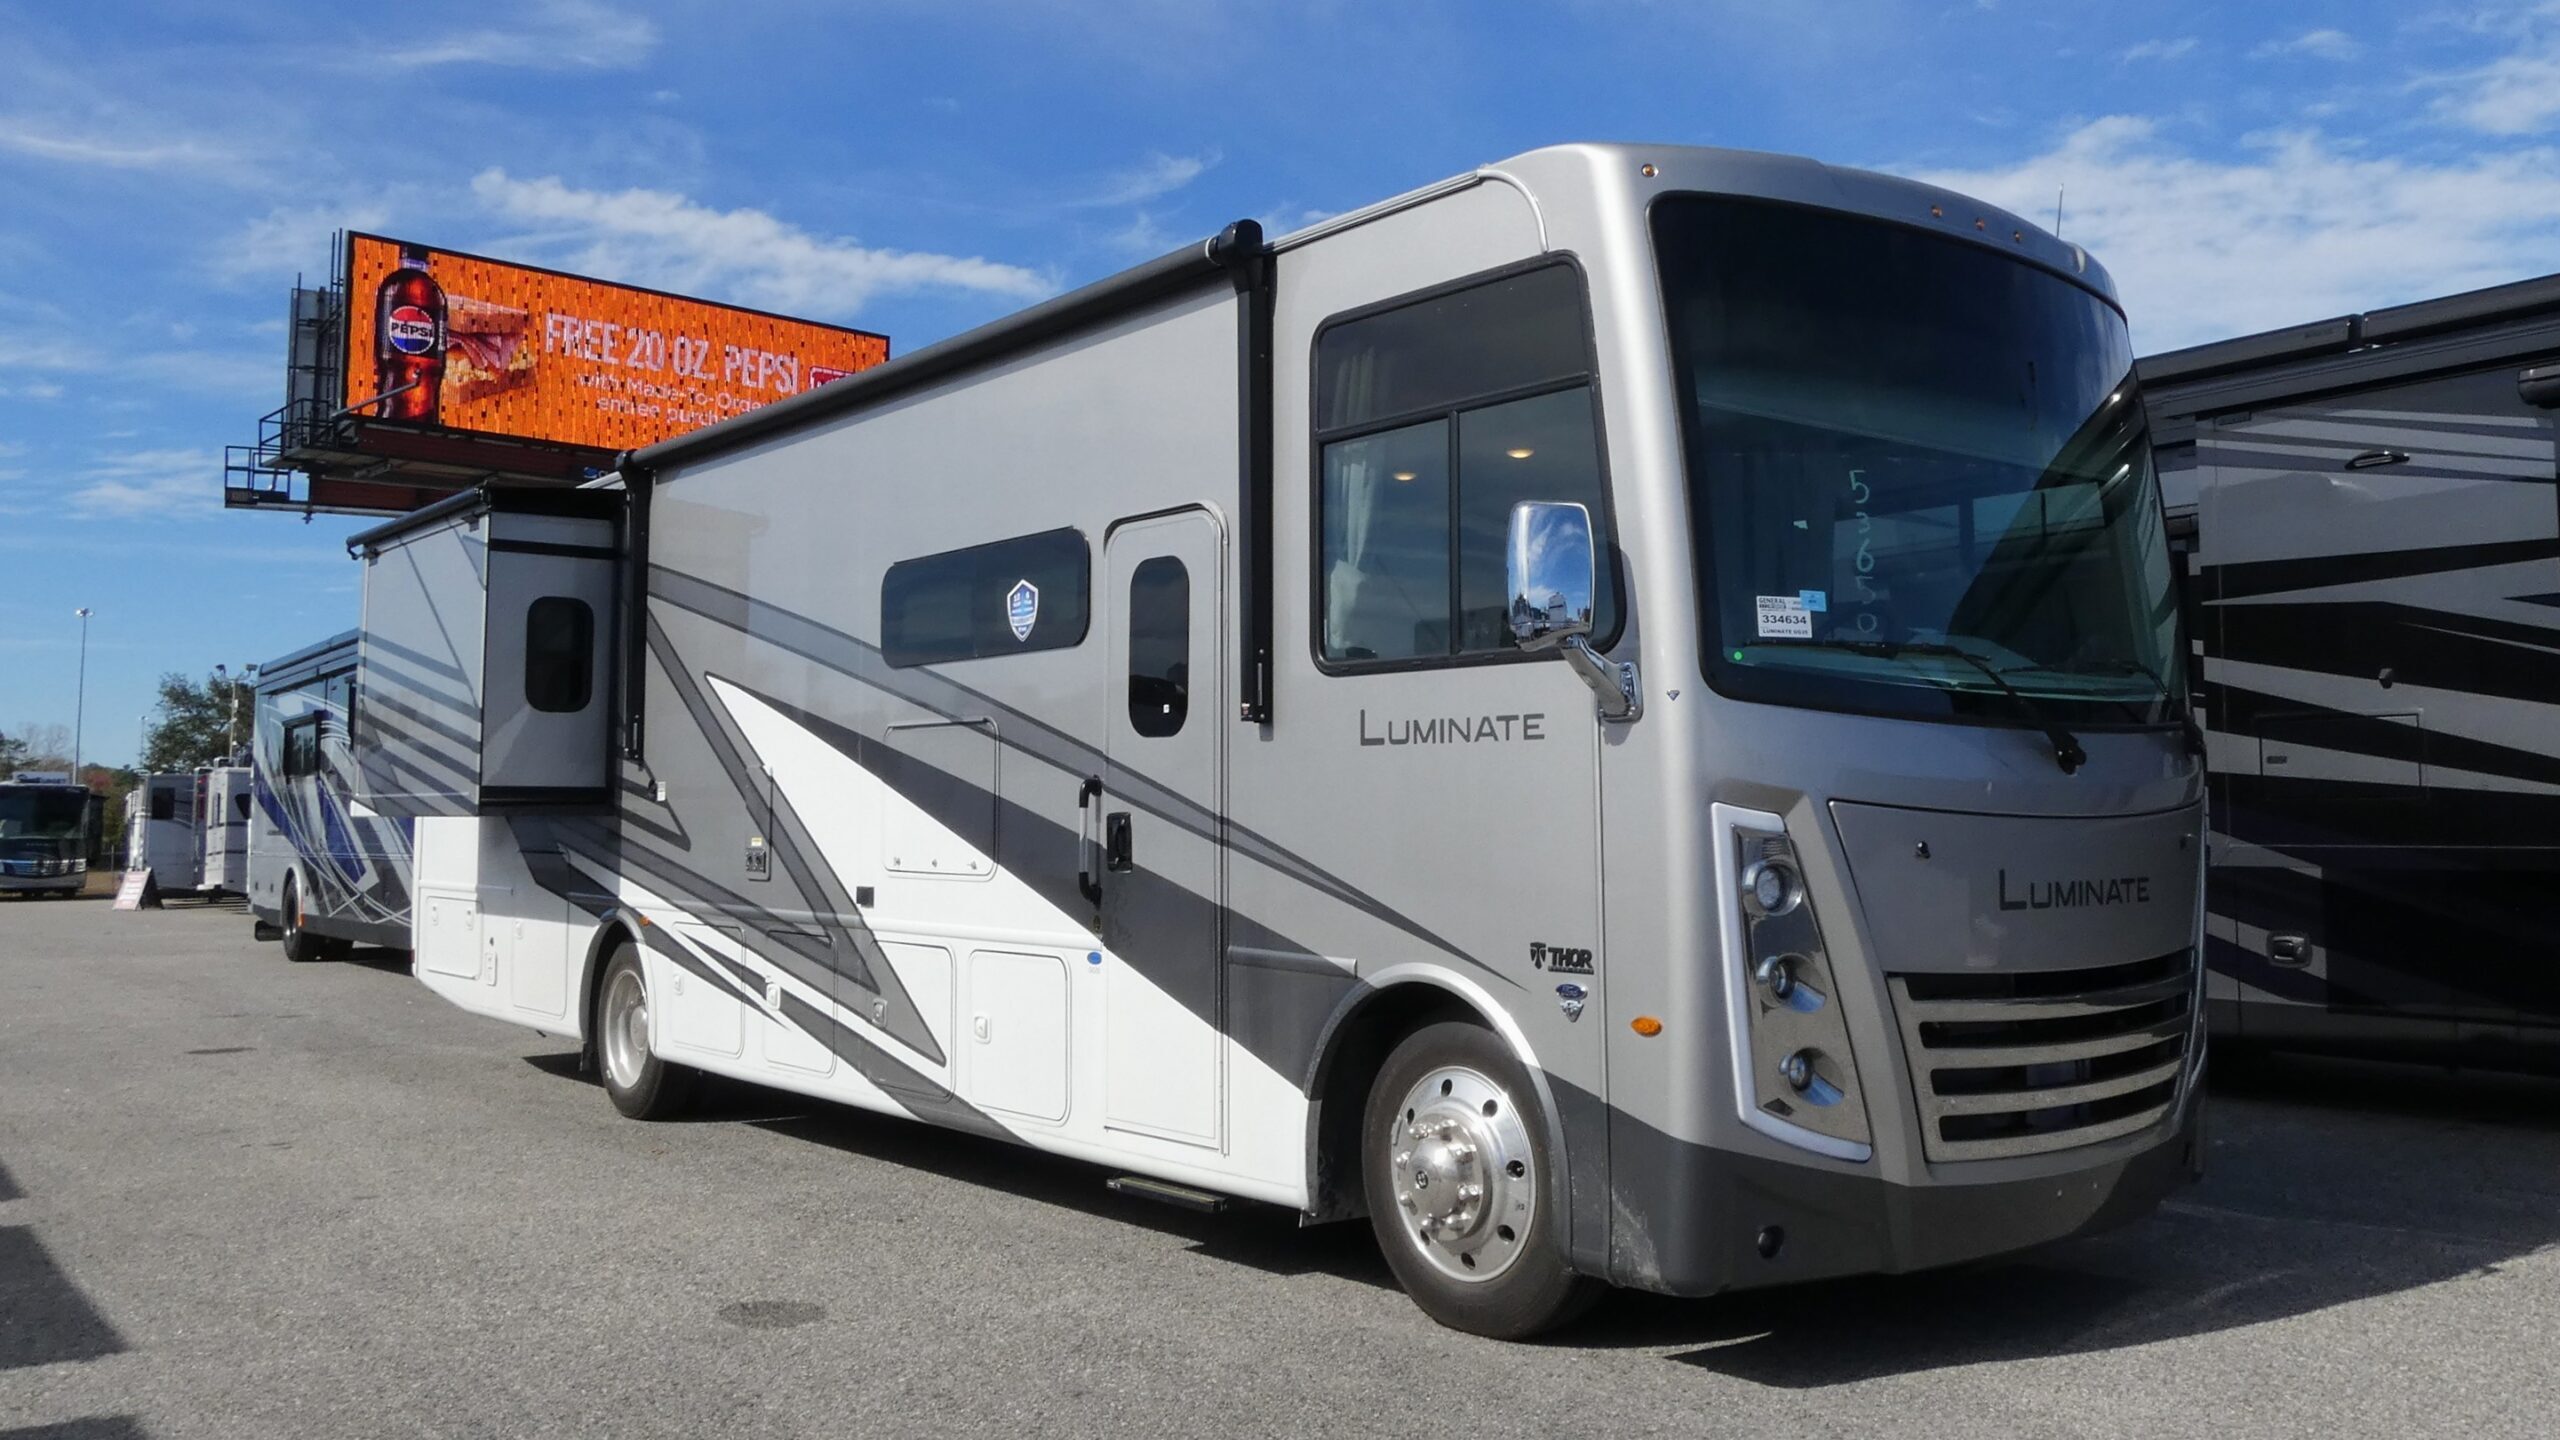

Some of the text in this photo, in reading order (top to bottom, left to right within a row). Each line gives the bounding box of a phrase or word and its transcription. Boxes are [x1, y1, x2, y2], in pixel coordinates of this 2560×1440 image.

[391, 322, 434, 338] PEPSI
[546, 312, 798, 395] FREE 20 OZ. PEPSI
[577, 373, 620, 392] with
[1762, 614, 1807, 625] 334634
[1360, 709, 1545, 746] LUMINATE
[1999, 868, 2149, 911] LUMINATE
[1547, 946, 1593, 970] THOR
